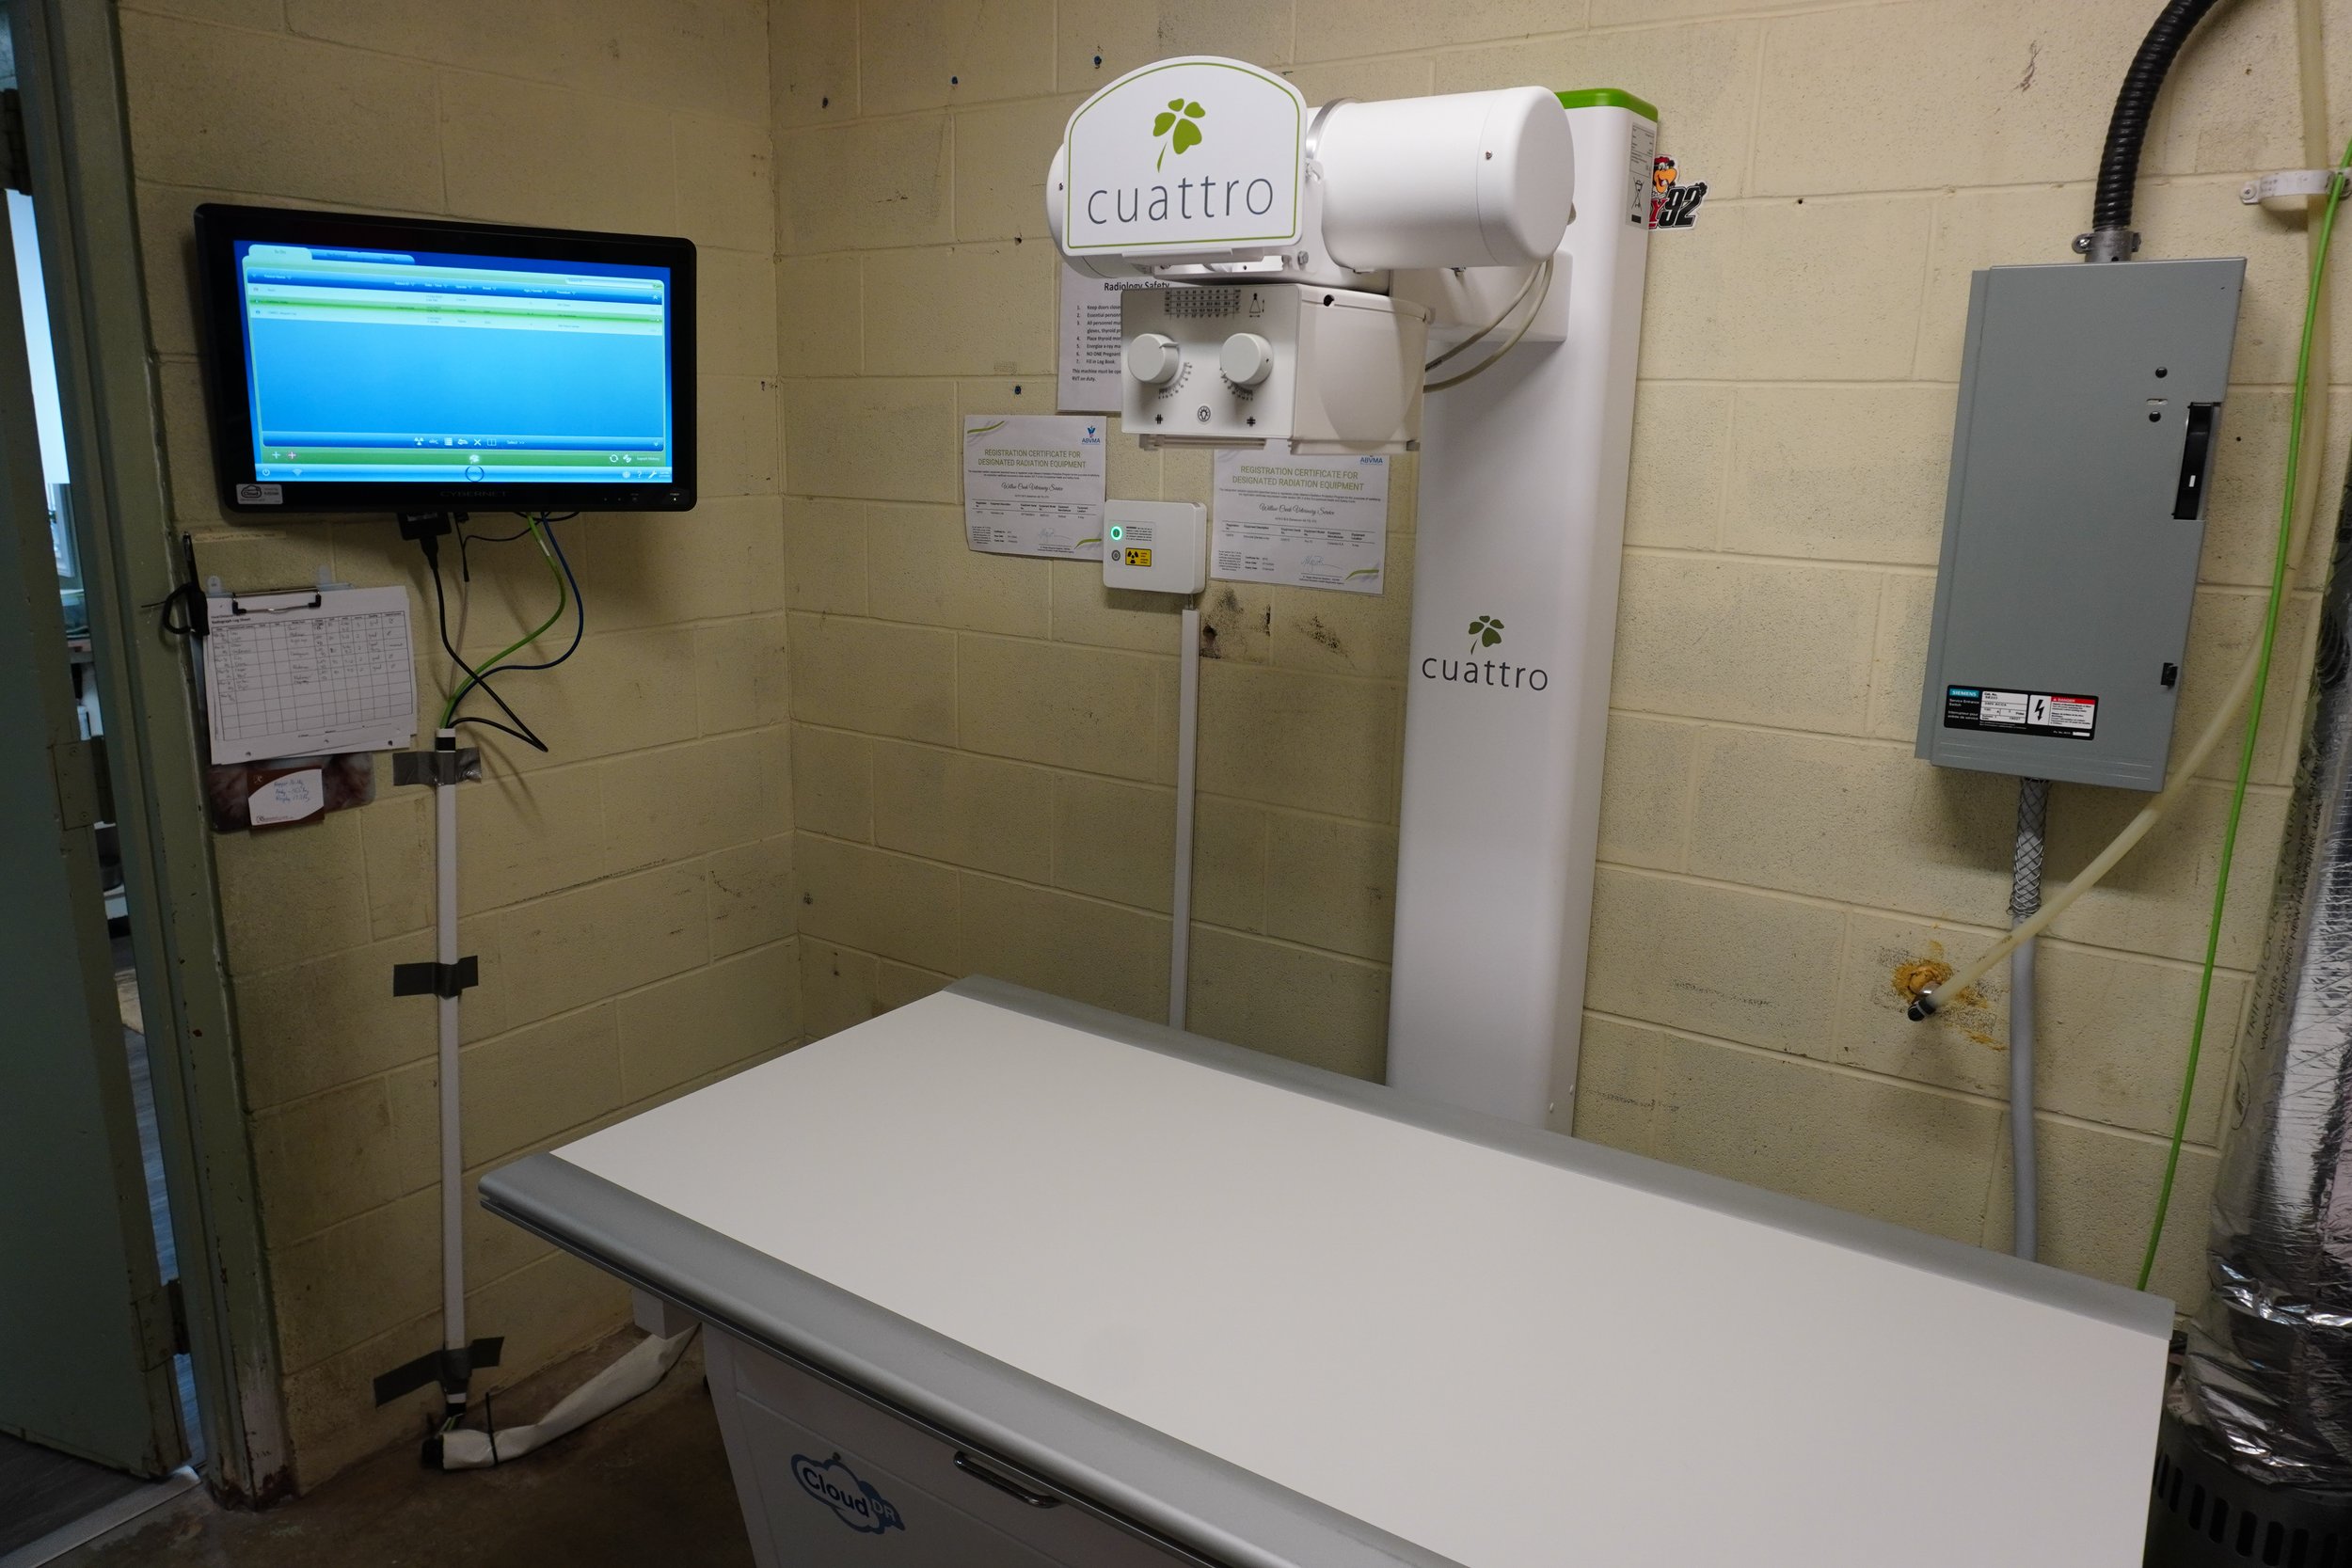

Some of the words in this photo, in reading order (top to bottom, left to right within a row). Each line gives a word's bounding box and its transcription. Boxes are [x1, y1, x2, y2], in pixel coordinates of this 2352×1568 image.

[1088, 176, 1273, 224] cuattro
[1104, 281, 1143, 291] Radiology
[1145, 280, 1170, 290] Safety
[984, 449, 1027, 457] REGISTRATION
[977, 458, 1015, 467] DESIGNATED
[1016, 459, 1049, 467] RADIATION
[1050, 460, 1086, 468] EQUIPMENT
[1240, 466, 1294, 476] REGISTRATION
[1295, 468, 1343, 479] CERTIFICATE
[1343, 471, 1359, 480] FOR
[1232, 476, 1278, 486] DESIGNATED
[1279, 478, 1318, 489] RADIATION
[1319, 481, 1364, 491] EQUIPMENT
[1422, 657, 1549, 690] cuattro
[803, 1467, 869, 1517] Cloud
